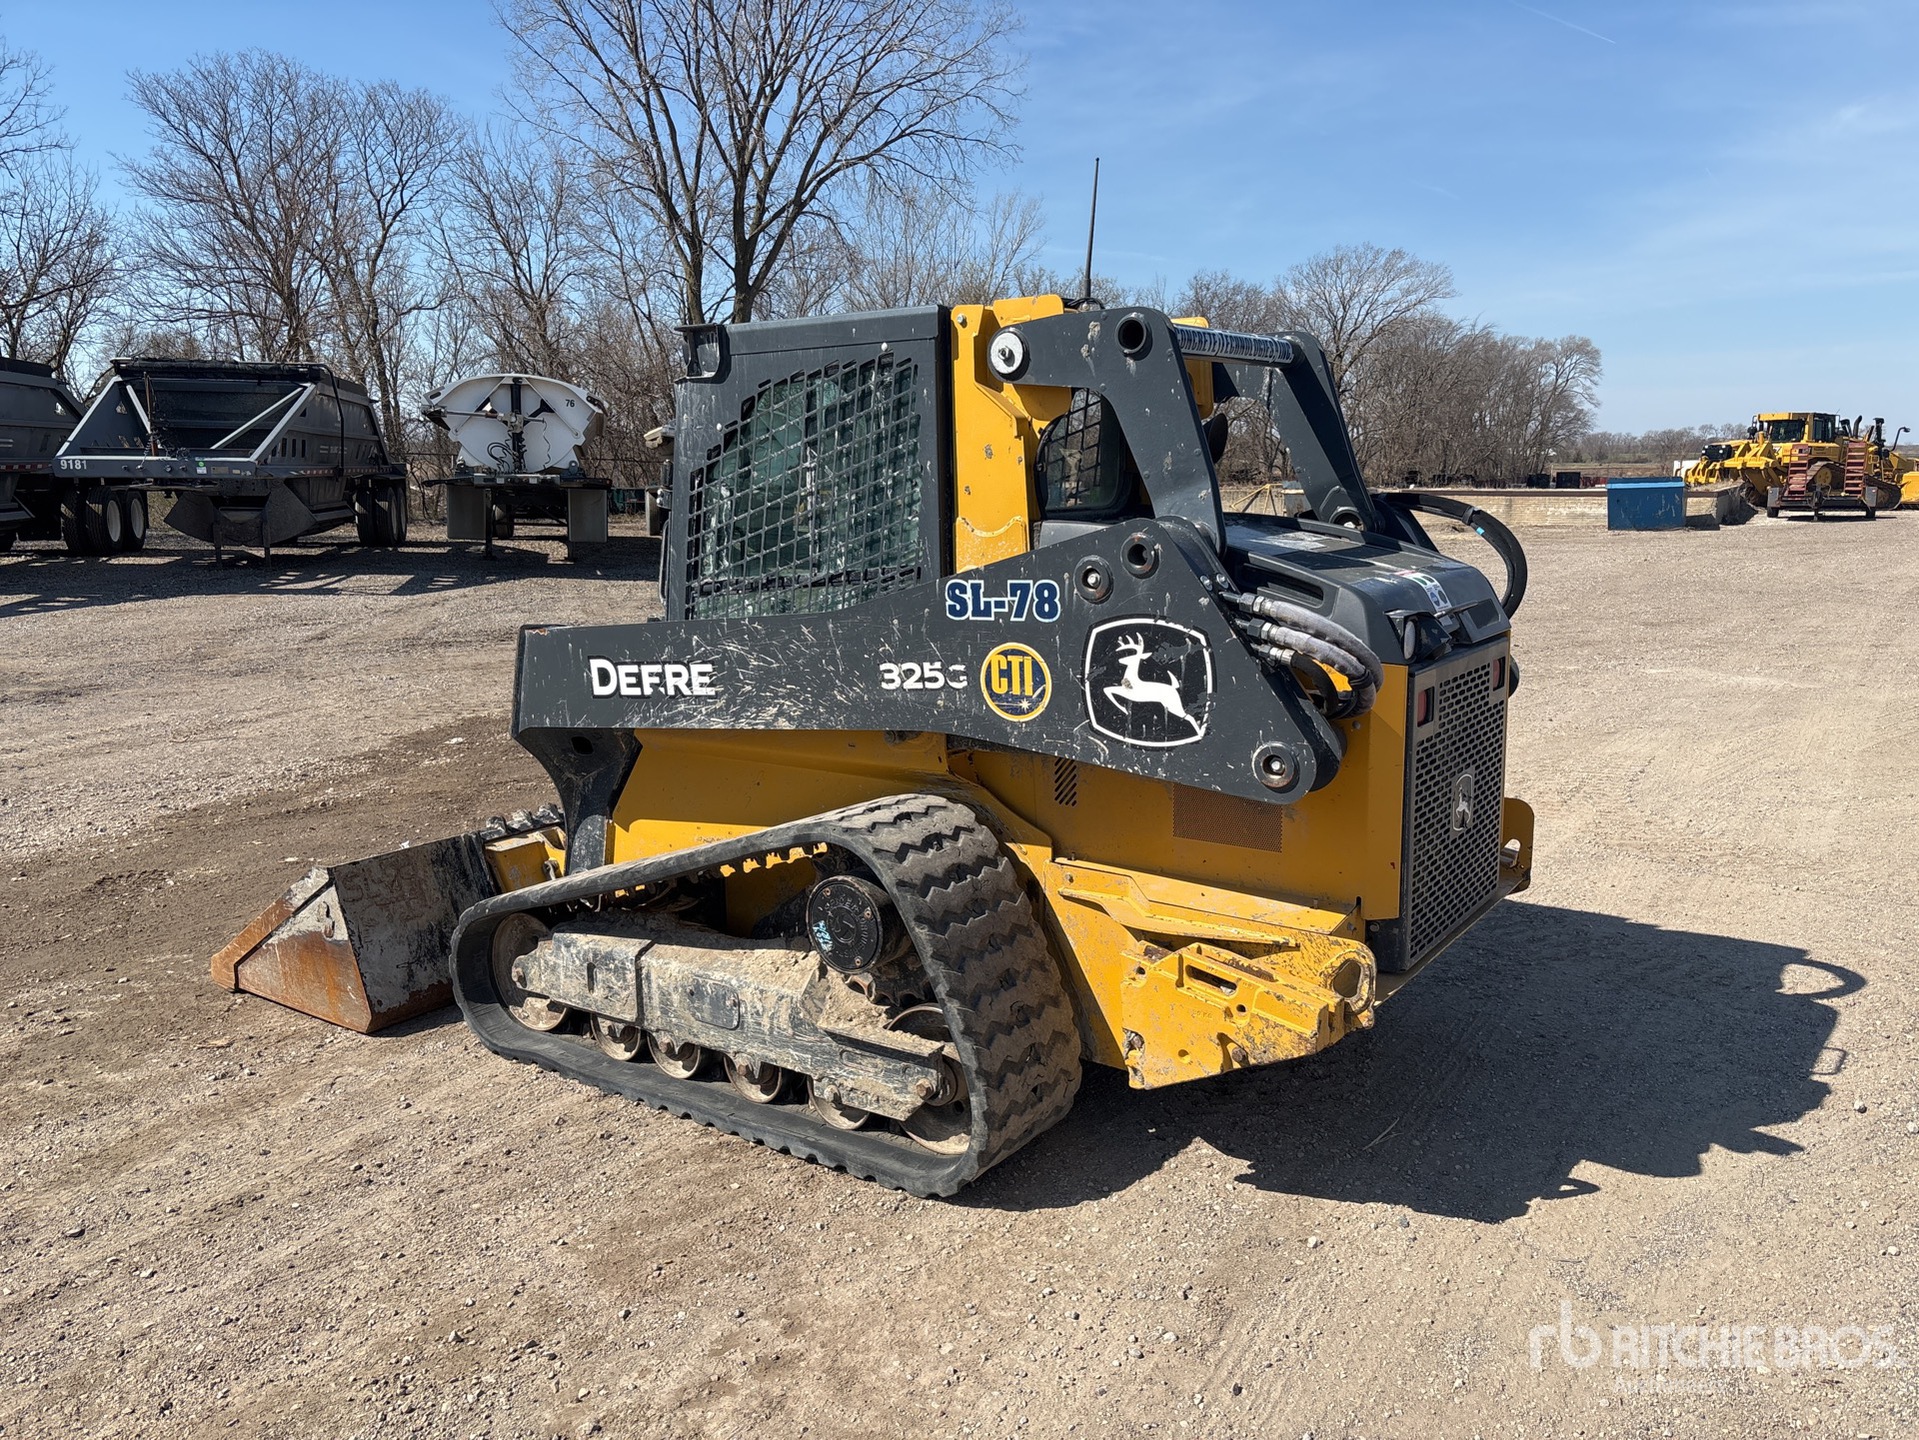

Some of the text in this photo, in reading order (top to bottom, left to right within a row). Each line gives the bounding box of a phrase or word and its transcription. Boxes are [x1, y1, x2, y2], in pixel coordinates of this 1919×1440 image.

[565, 399, 576, 408] 76
[60, 459, 88, 470] 9181
[945, 579, 1061, 623] SL-78
[990, 654, 1034, 697] CTI
